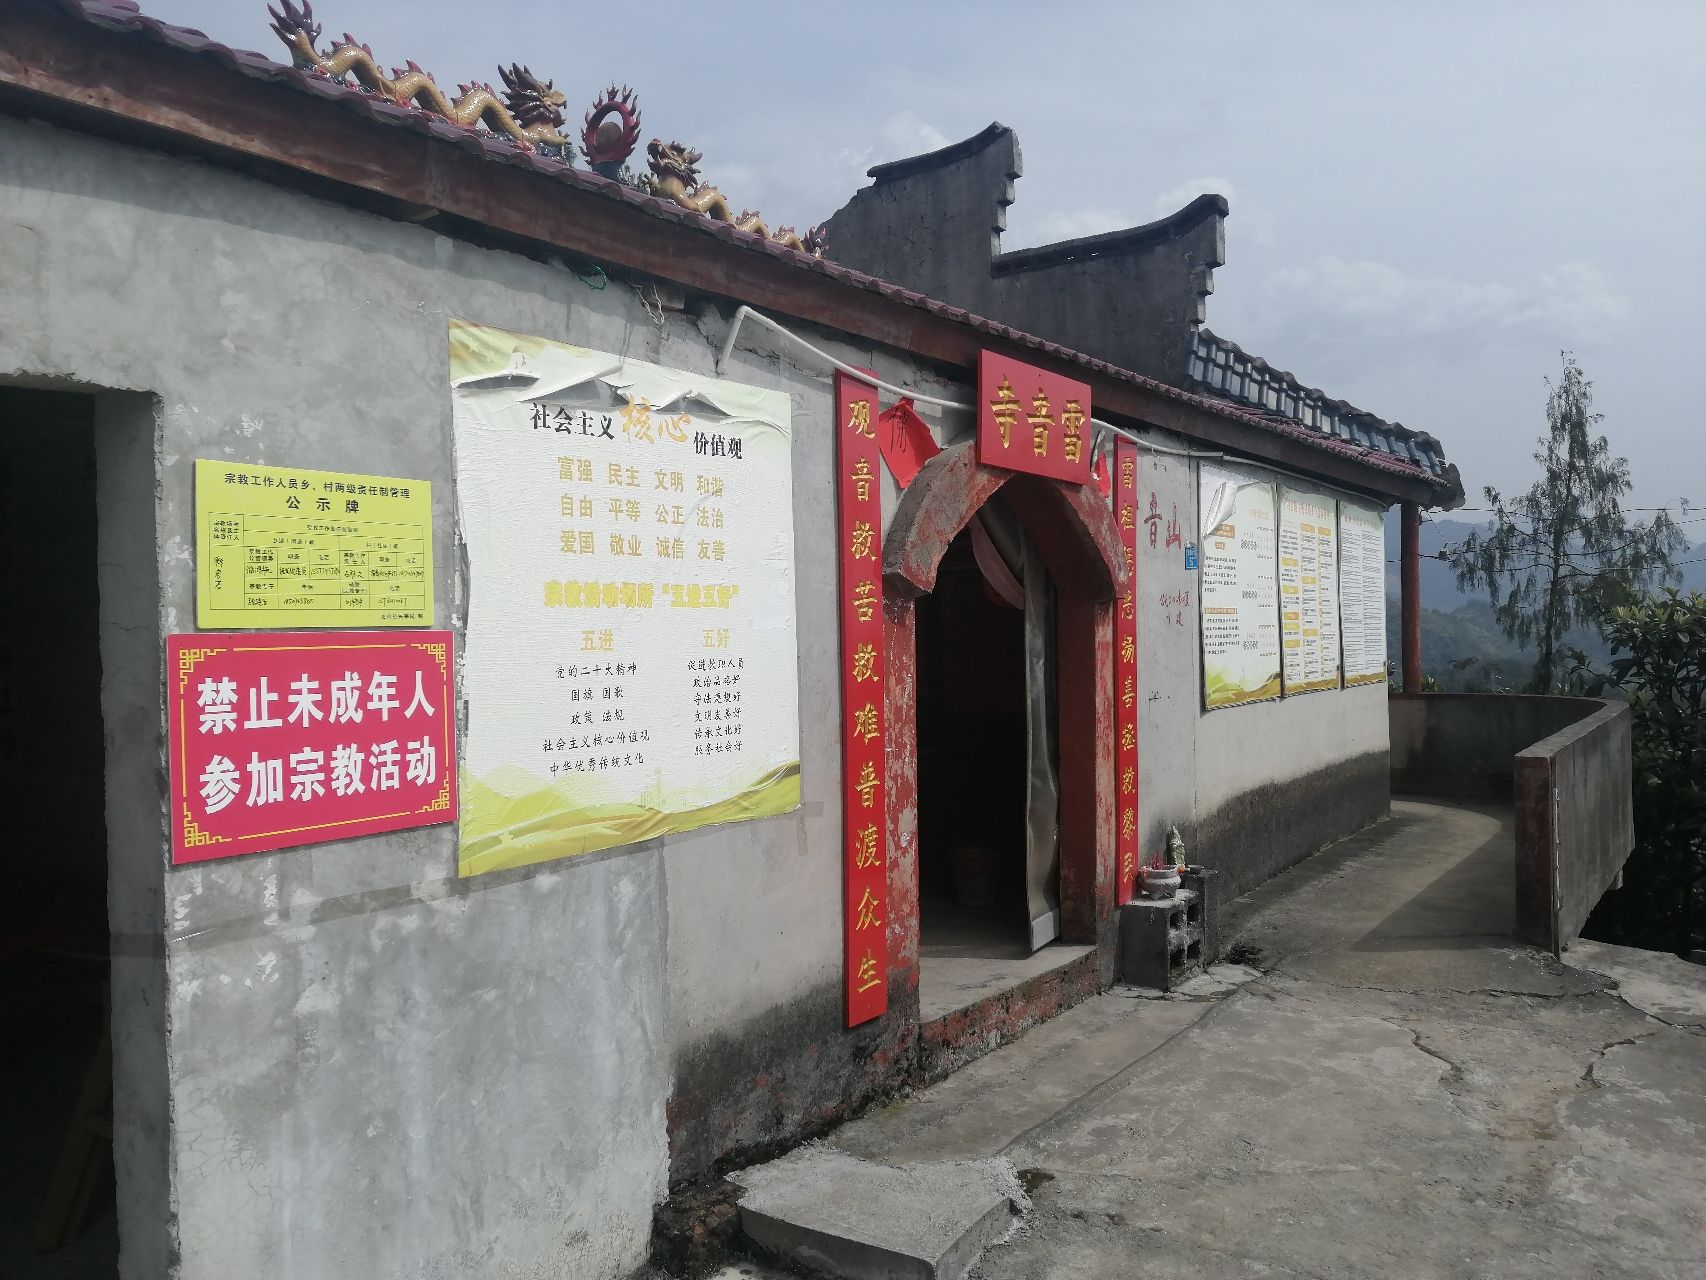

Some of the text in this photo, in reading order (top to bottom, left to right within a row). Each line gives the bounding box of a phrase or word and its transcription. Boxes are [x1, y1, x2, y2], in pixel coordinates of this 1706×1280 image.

[224, 472, 411, 499] 宗教工作人员乡、村两级责任制管理
[557, 456, 724, 498] 富强 民主 文明 和谐
[286, 495, 360, 514] 公示牌
[560, 493, 724, 529] 自由 平等 公正 法治
[560, 530, 726, 562] 爱国 敬业 诚信 友善
[580, 628, 615, 652] 五进
[702, 628, 730, 649] 五好
[555, 661, 638, 679] 党的二十大精神
[197, 670, 436, 735] 禁止未成年人
[542, 728, 651, 753] 社会主义核心价值观
[199, 735, 437, 815] 参加宗教活动
[549, 752, 645, 778] 中华优秀传统文化
